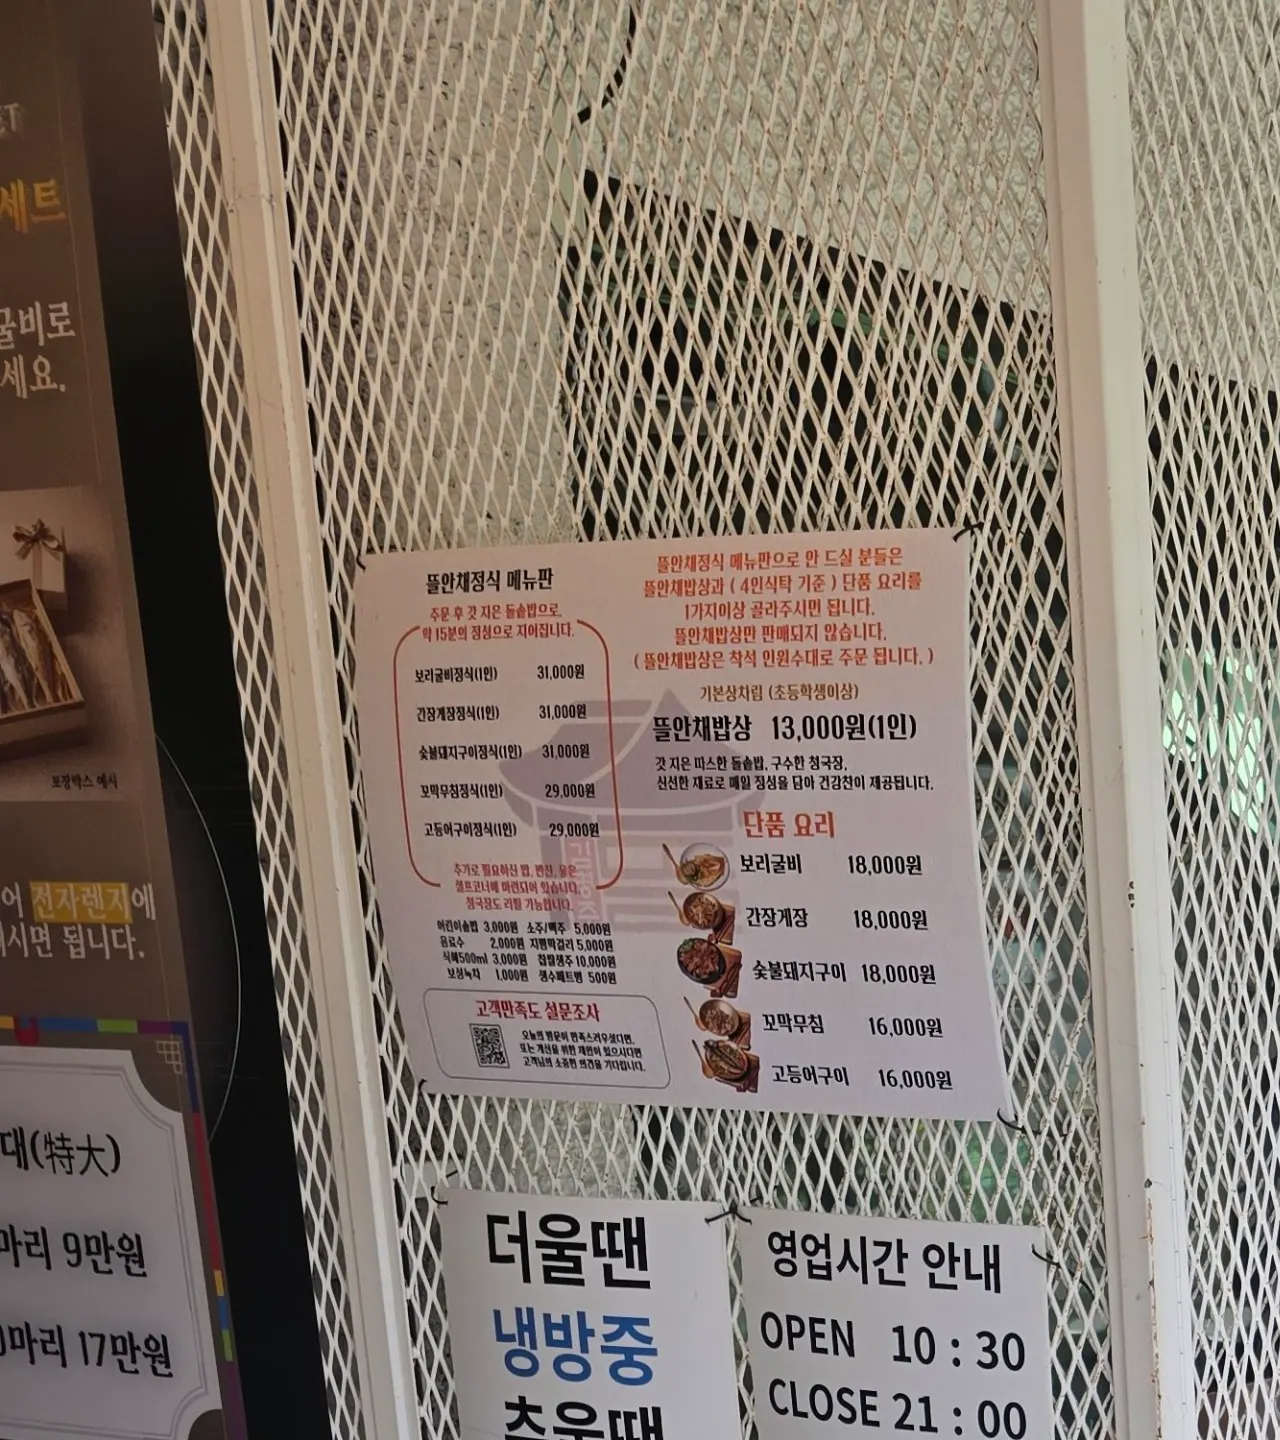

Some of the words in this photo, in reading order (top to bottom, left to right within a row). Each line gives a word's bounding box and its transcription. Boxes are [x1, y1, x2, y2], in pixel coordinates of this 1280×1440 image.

[657, 553, 725, 573] 뜰안채정식
[730, 551, 799, 571] 메뉴판으로
[805, 550, 819, 568] 안
[823, 548, 852, 567] 드실
[857, 547, 903, 566] 분들은
[426, 570, 500, 594] 뜰안채정식
[507, 567, 554, 590] 메뉴판
[644, 578, 724, 598] 뜰안채밥상과
[740, 575, 792, 595] 4인식탁
[798, 574, 826, 593] 기준
[842, 573, 871, 592] 단품
[877, 571, 921, 591] 요리를
[430, 606, 450, 622] 주문
[453, 606, 464, 621] 후
[480, 604, 502, 620] 지은
[685, 601, 745, 620] 1가지이상
[750, 599, 821, 619] 골라주시면
[827, 597, 875, 617] 됩니다.
[471, 624, 513, 641] 정성으로
[516, 622, 574, 639] 지어집니다.
[675, 625, 756, 645] 뜰안채밥상만
[762, 623, 819, 643] 판매되지
[824, 622, 886, 642] 않습니다.
[644, 651, 724, 670] 뜰안채밥상은
[729, 650, 756, 669] 착석
[762, 648, 834, 668] 인원수대로
[838, 648, 868, 666] 주문
[872, 647, 923, 666] 됩니다.
[415, 666, 498, 684] 보리굴비정식(1인)
[537, 664, 585, 680] 31,000원
[700, 685, 763, 703] 기본상차림
[768, 683, 859, 701] (초등학생이상)
[417, 706, 500, 722] 간장게장정식(1인)
[539, 704, 587, 720] 31,000원
[652, 715, 752, 742] 뜰안채밥상
[772, 713, 917, 743] 13,000원(1인)
[542, 744, 590, 760] 31,000원
[669, 756, 691, 771] 지은
[694, 755, 727, 771] 따스한
[771, 755, 804, 771] 구수한
[52, 774, 94, 790] 포장박스
[97, 773, 118, 789] 예시
[420, 783, 503, 799] 꼬막무침정식(1인)
[545, 783, 596, 799] 29,000원
[657, 775, 689, 791] 신선한
[692, 775, 726, 790] 재료로
[729, 775, 751, 790] 매일
[754, 775, 788, 790] 정성을
[792, 775, 815, 790] 담아
[818, 774, 866, 790] 건강찬이
[869, 775, 934, 791] 제공됩니다.
[424, 822, 517, 838] 고등어구이정식(1인)
[549, 822, 600, 838] 29,000원
[743, 811, 785, 838] 단품
[794, 811, 836, 838] 요리
[741, 854, 802, 874] 보리굴비
[848, 855, 922, 876] 18,000원
[31, 882, 156, 921] 전자렌지에
[483, 921, 518, 934] 3,000원
[746, 907, 808, 928] 간장게장
[854, 909, 928, 931] 18,000원
[574, 923, 611, 935] 5,000원
[63, 924, 145, 960] 됩니다.
[490, 937, 525, 950] 2,000원
[577, 940, 614, 952] 5,000원
[492, 953, 528, 966] 3,000원
[576, 955, 616, 969] 10,000원
[495, 969, 529, 982] 1,000원
[588, 971, 617, 984] 500원
[752, 960, 846, 983] 숯불돼지구이
[862, 963, 936, 985] 18,000원
[476, 1000, 542, 1019] 고객만족도
[545, 1003, 600, 1022] 설문조사
[762, 1013, 824, 1034] 꼬막무침
[869, 1017, 943, 1038] 16,000원
[772, 1065, 850, 1086] 고등어구이
[878, 1069, 953, 1090] 16,000원
[63, 1230, 147, 1278] 9만원
[486, 1211, 652, 1289] 더울땐
[767, 1230, 907, 1290] 영업시간
[921, 1243, 1002, 1293] 안내
[760, 1311, 856, 1358] OPEN
[78, 1330, 173, 1378] 17만원
[493, 1307, 658, 1387] 냉방중
[768, 1378, 880, 1427] CLOSE
